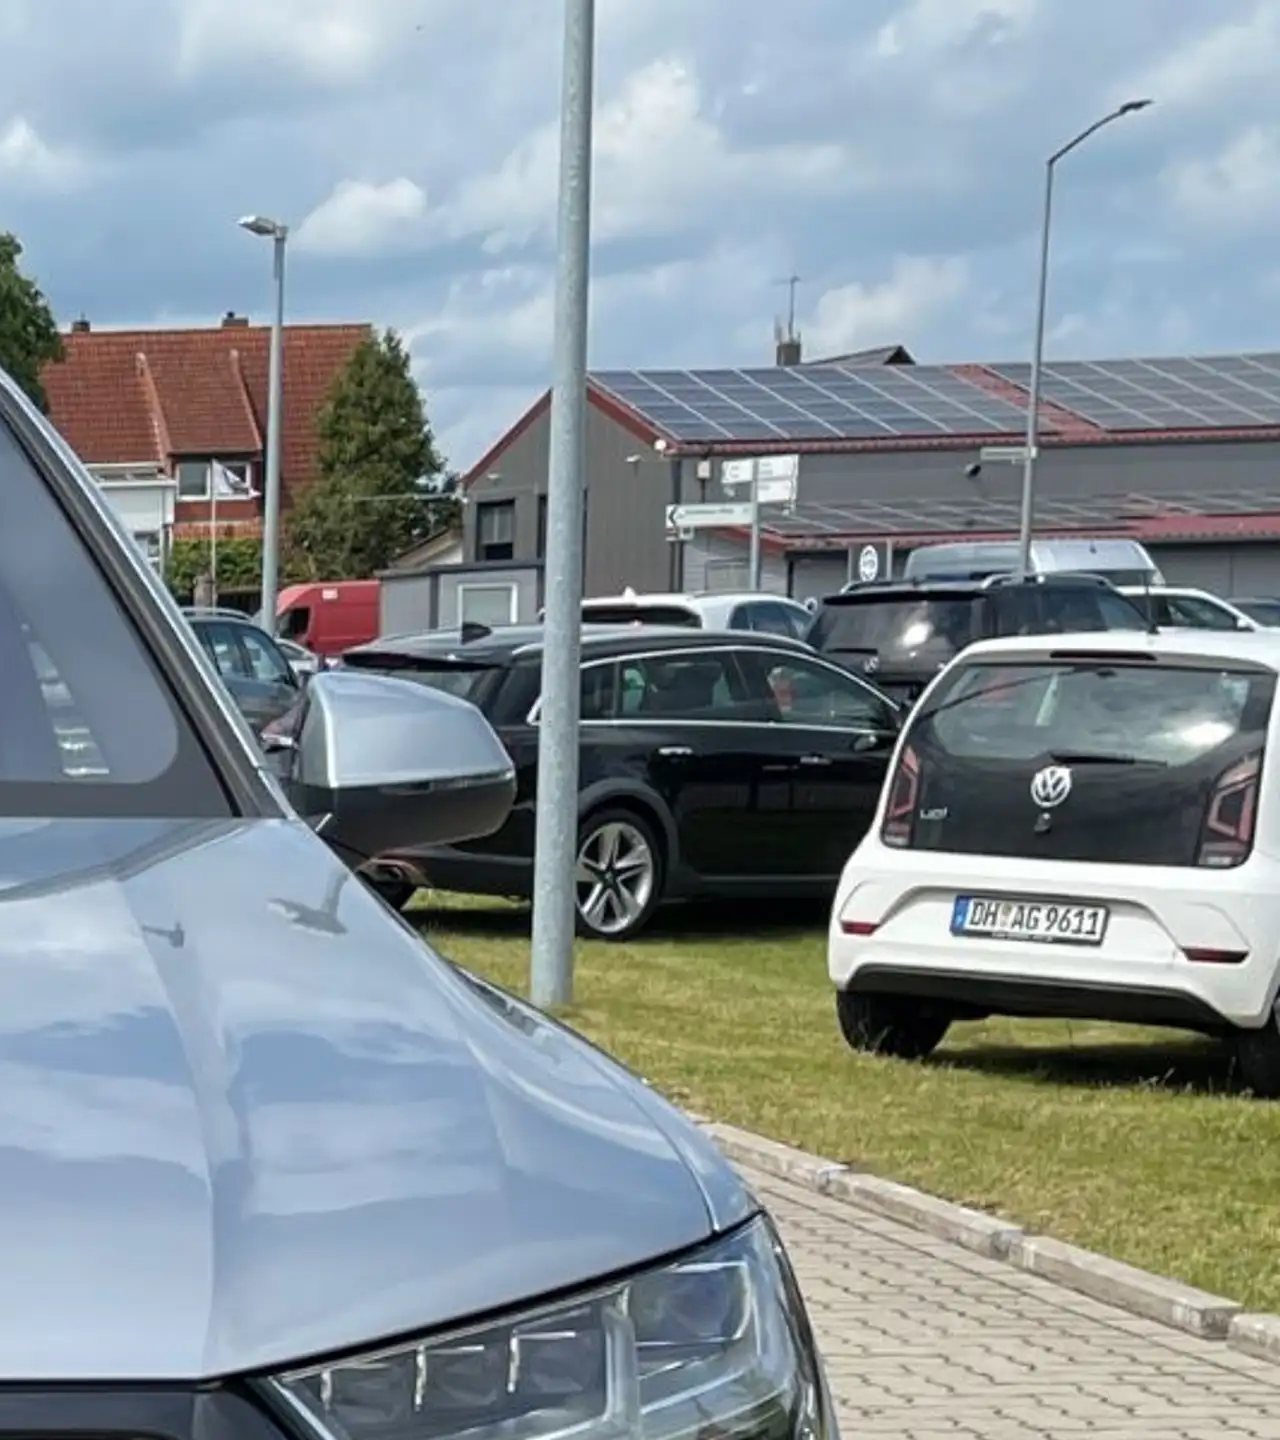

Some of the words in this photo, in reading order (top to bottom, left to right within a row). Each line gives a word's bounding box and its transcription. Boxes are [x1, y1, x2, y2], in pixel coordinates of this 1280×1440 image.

[970, 901, 1000, 926] DH
[1011, 904, 1041, 930] AG
[1045, 906, 1098, 935] 9611
